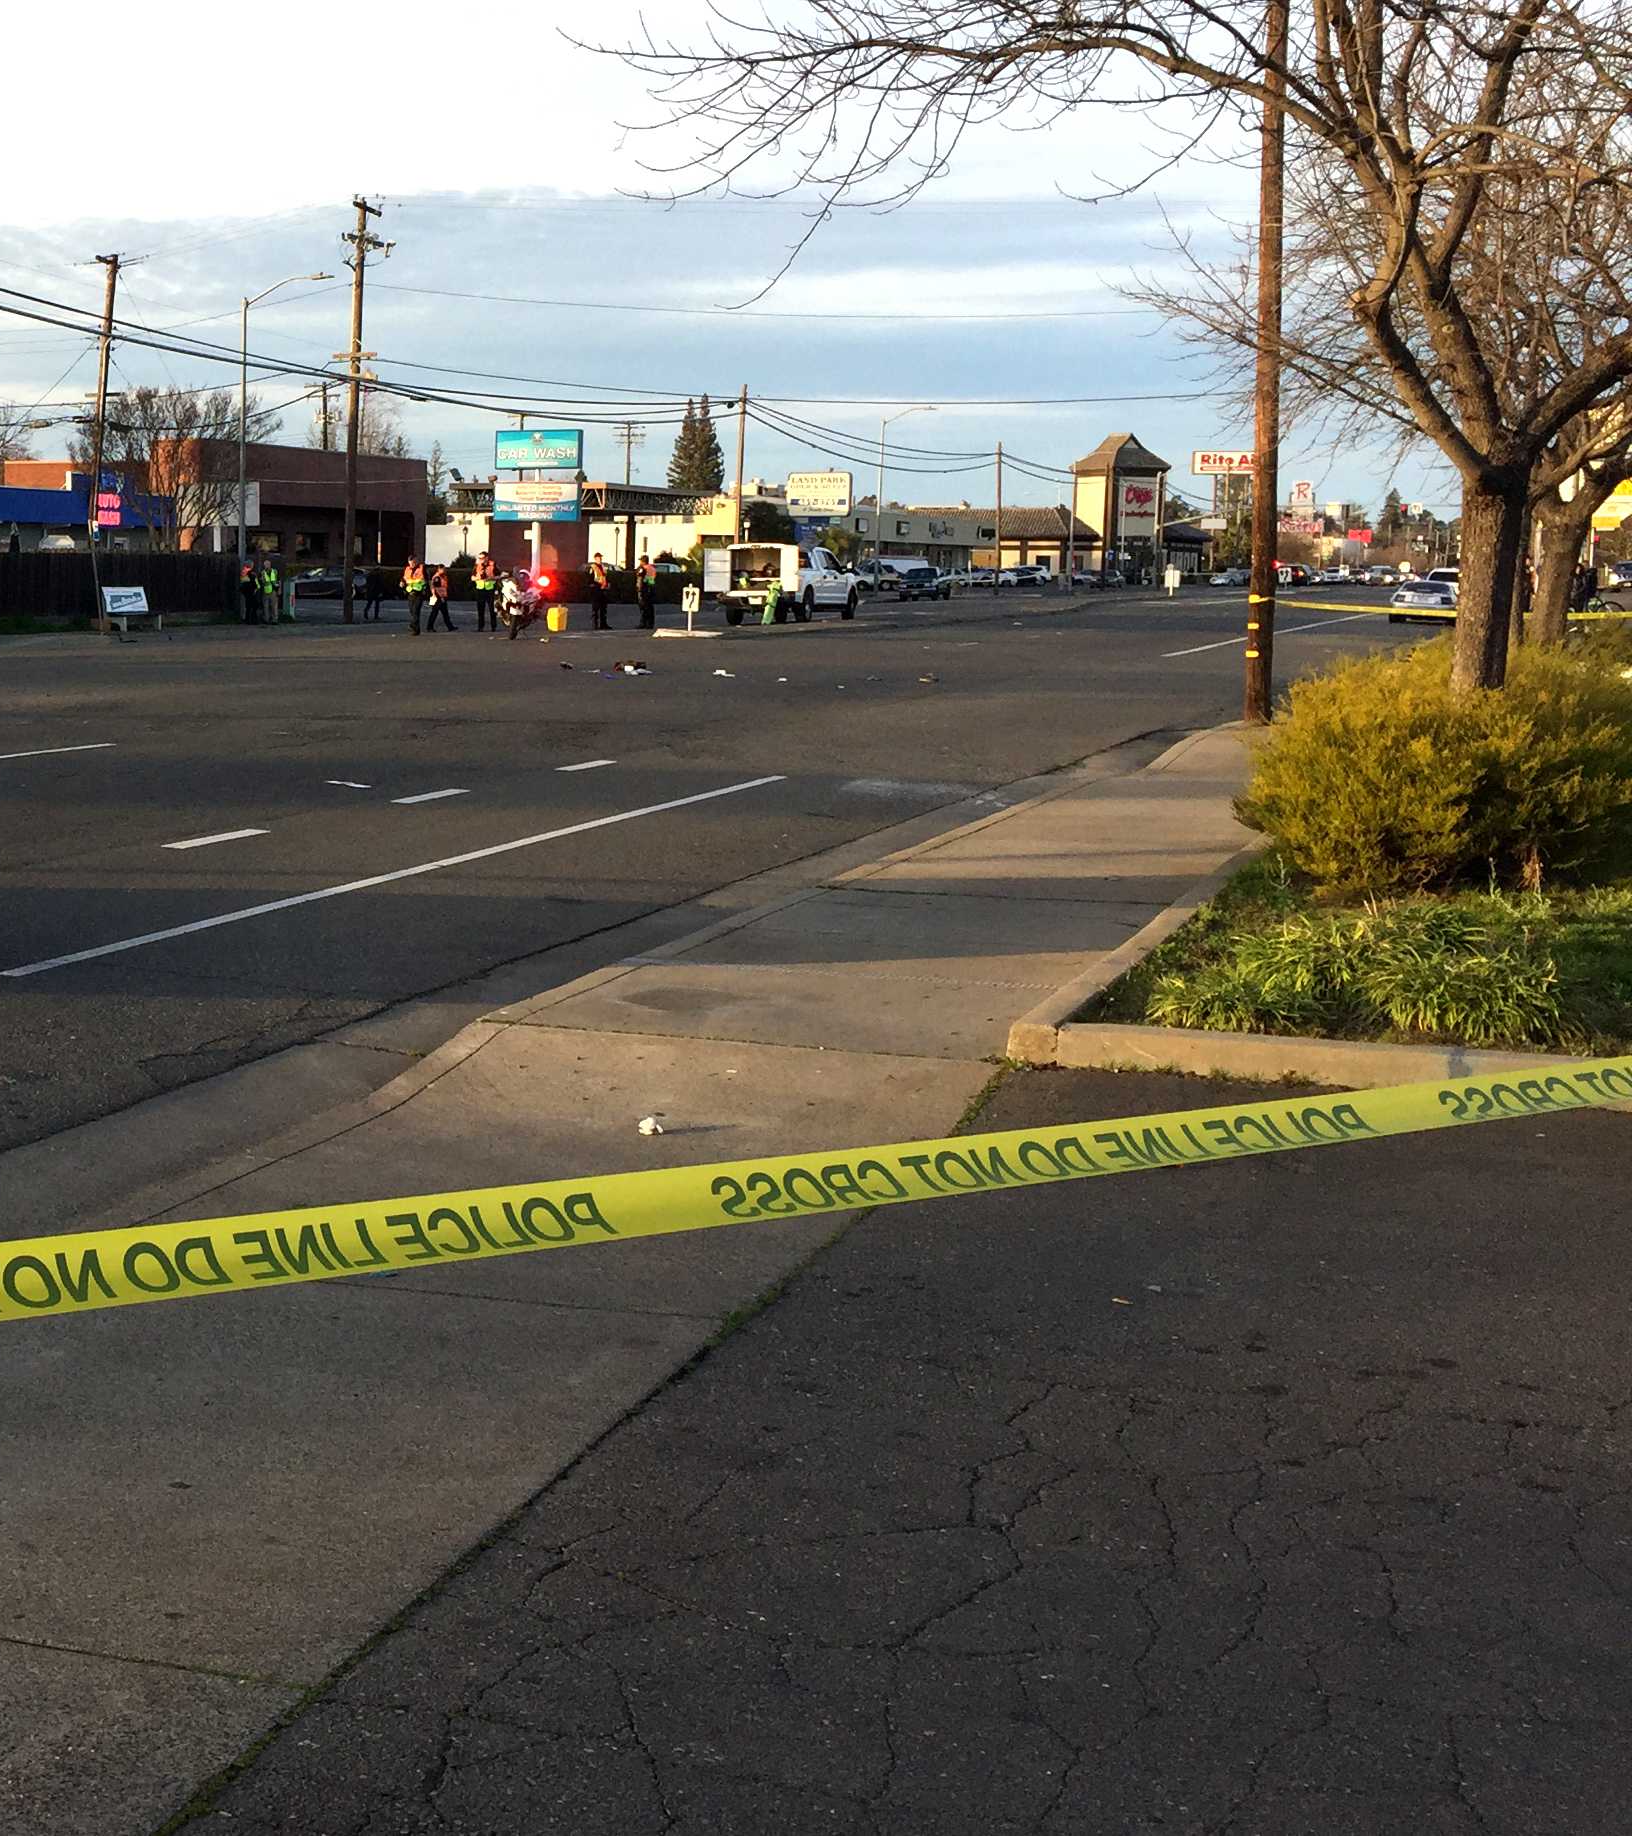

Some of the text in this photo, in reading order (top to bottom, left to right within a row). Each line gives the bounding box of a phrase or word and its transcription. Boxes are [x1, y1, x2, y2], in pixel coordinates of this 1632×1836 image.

[496, 447, 576, 459] CAR WASH
[1200, 454, 1255, 465] Rite Ai
[1295, 482, 1311, 499] R
[539, 503, 575, 512] MONTHLY
